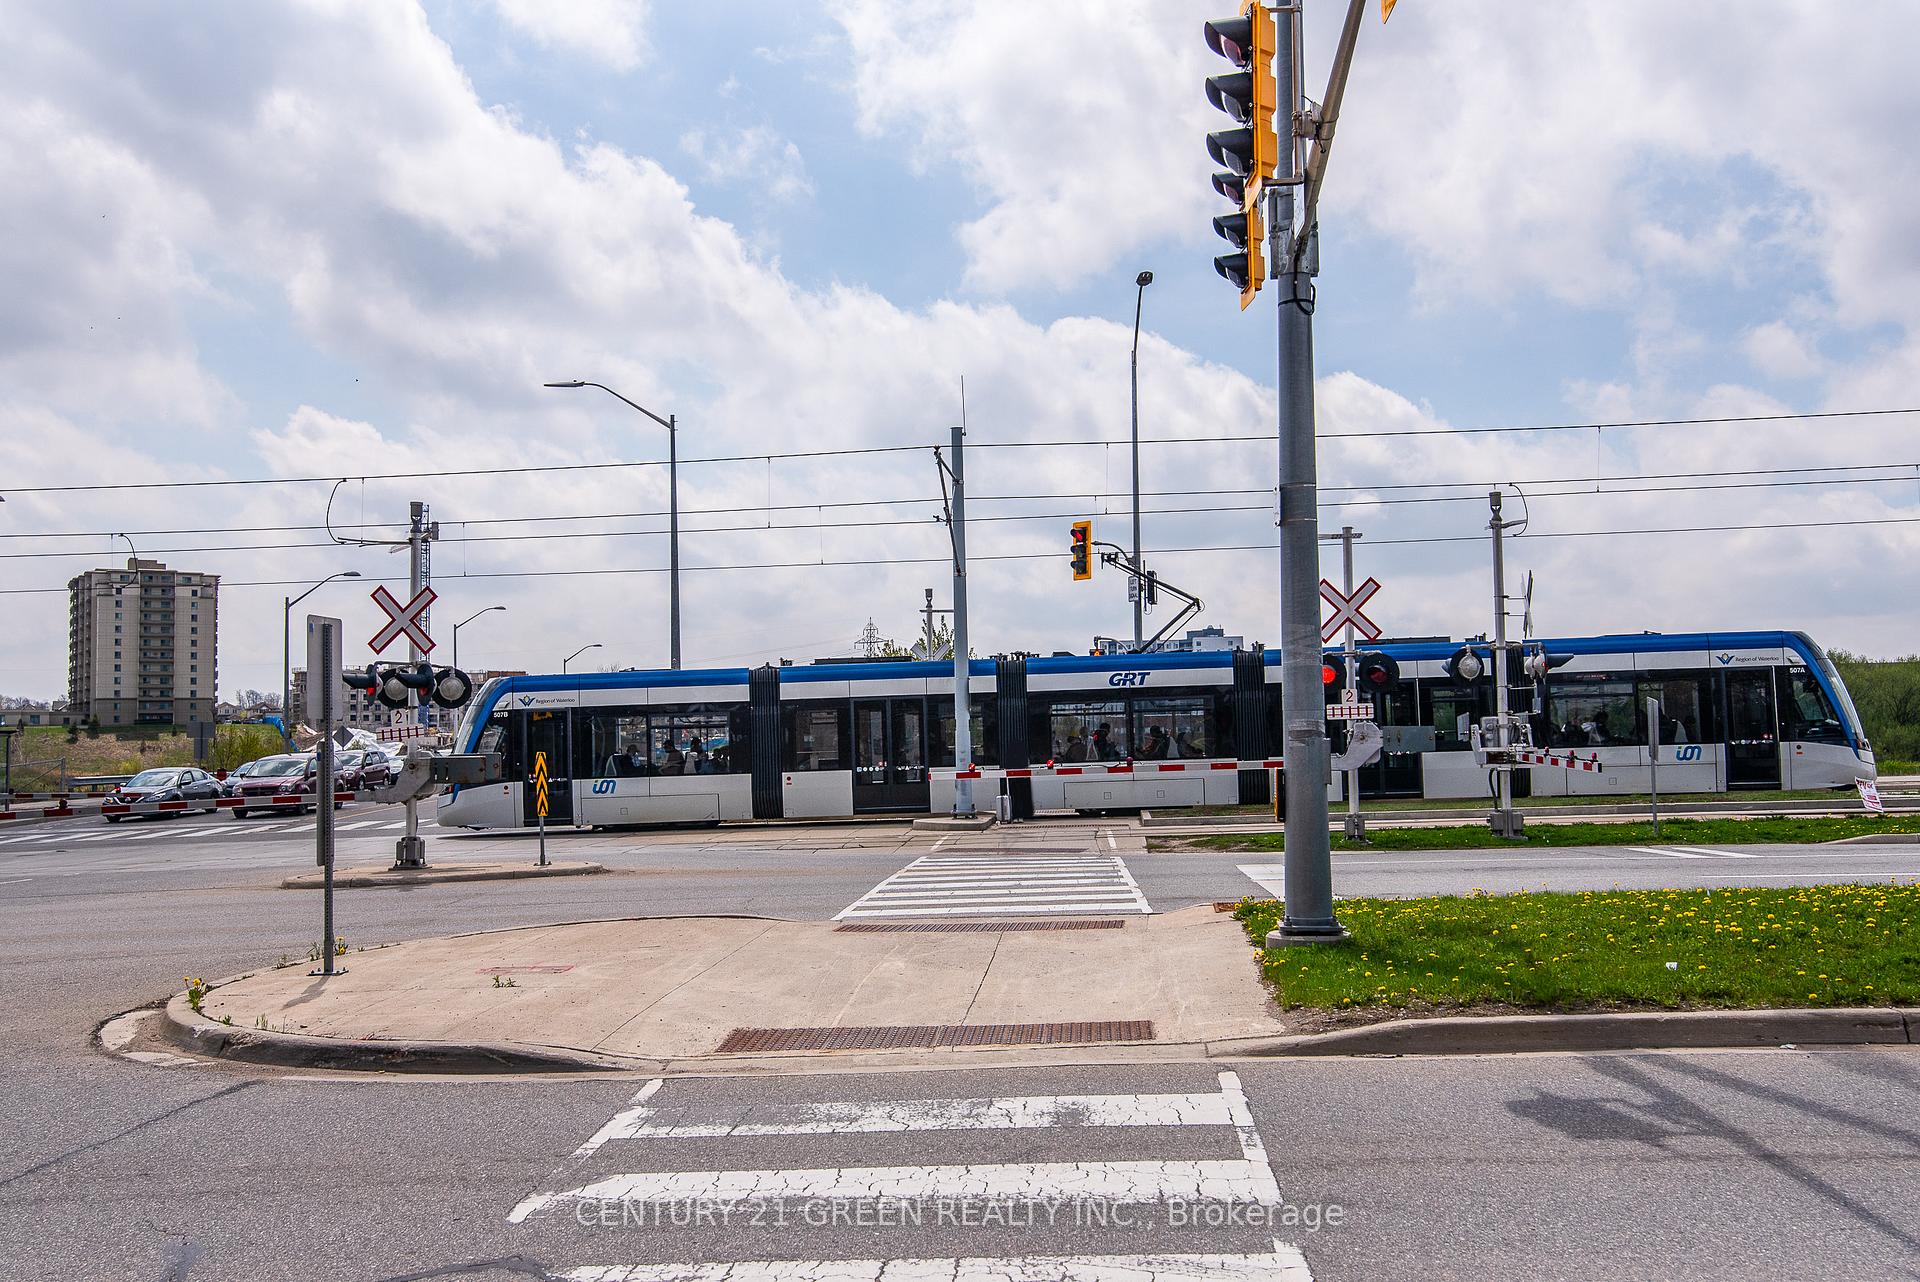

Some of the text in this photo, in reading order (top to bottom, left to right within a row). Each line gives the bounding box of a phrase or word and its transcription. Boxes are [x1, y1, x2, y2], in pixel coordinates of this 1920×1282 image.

[1109, 672, 1151, 686] GRT
[1346, 690, 1354, 702] 2
[395, 710, 403, 723] 2
